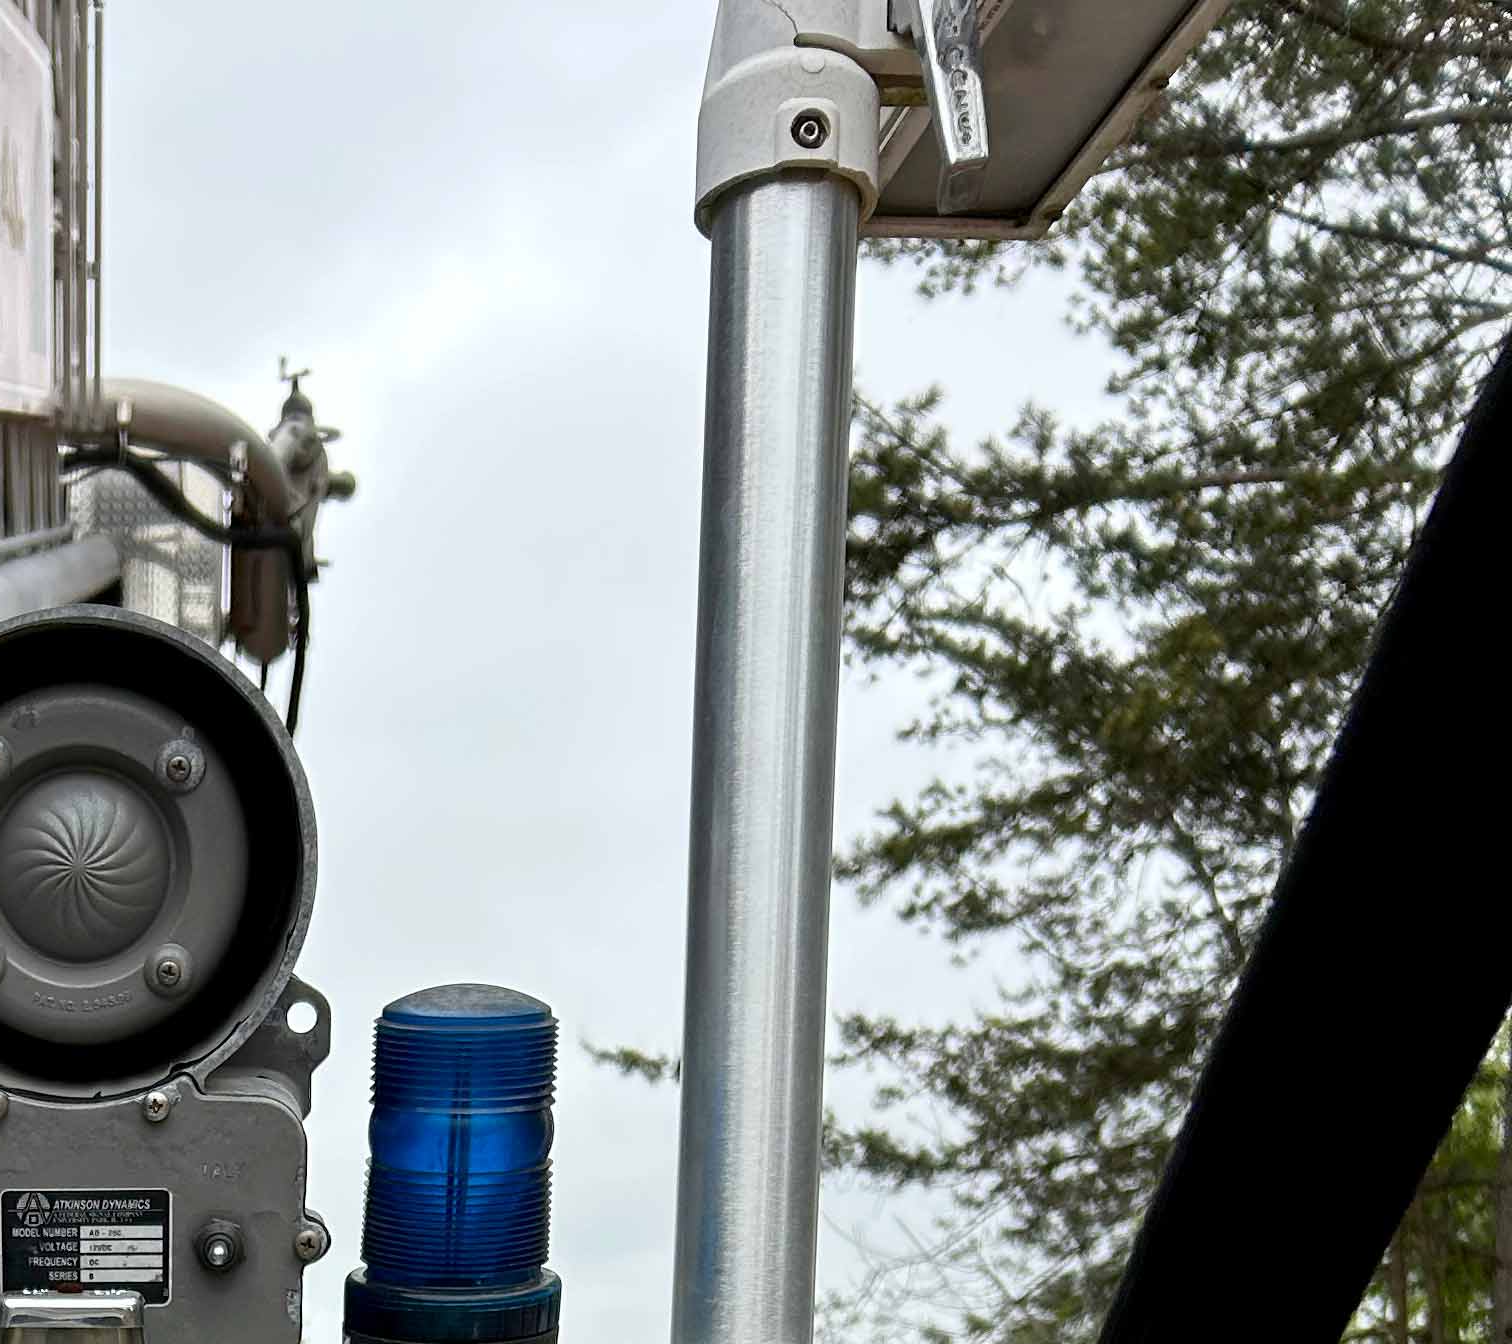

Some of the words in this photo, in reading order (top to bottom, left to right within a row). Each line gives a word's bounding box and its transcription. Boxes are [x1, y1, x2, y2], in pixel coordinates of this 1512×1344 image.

[53, 1199, 100, 1210] ATKINSON
[102, 1199, 151, 1210] DYNAMICS
[12, 1227, 40, 1238] MODEL
[43, 1227, 78, 1237] NUMBER
[39, 1242, 78, 1252] VOLTAGE
[28, 1256, 79, 1267] FREQUENCY
[48, 1271, 79, 1281] SERIES
